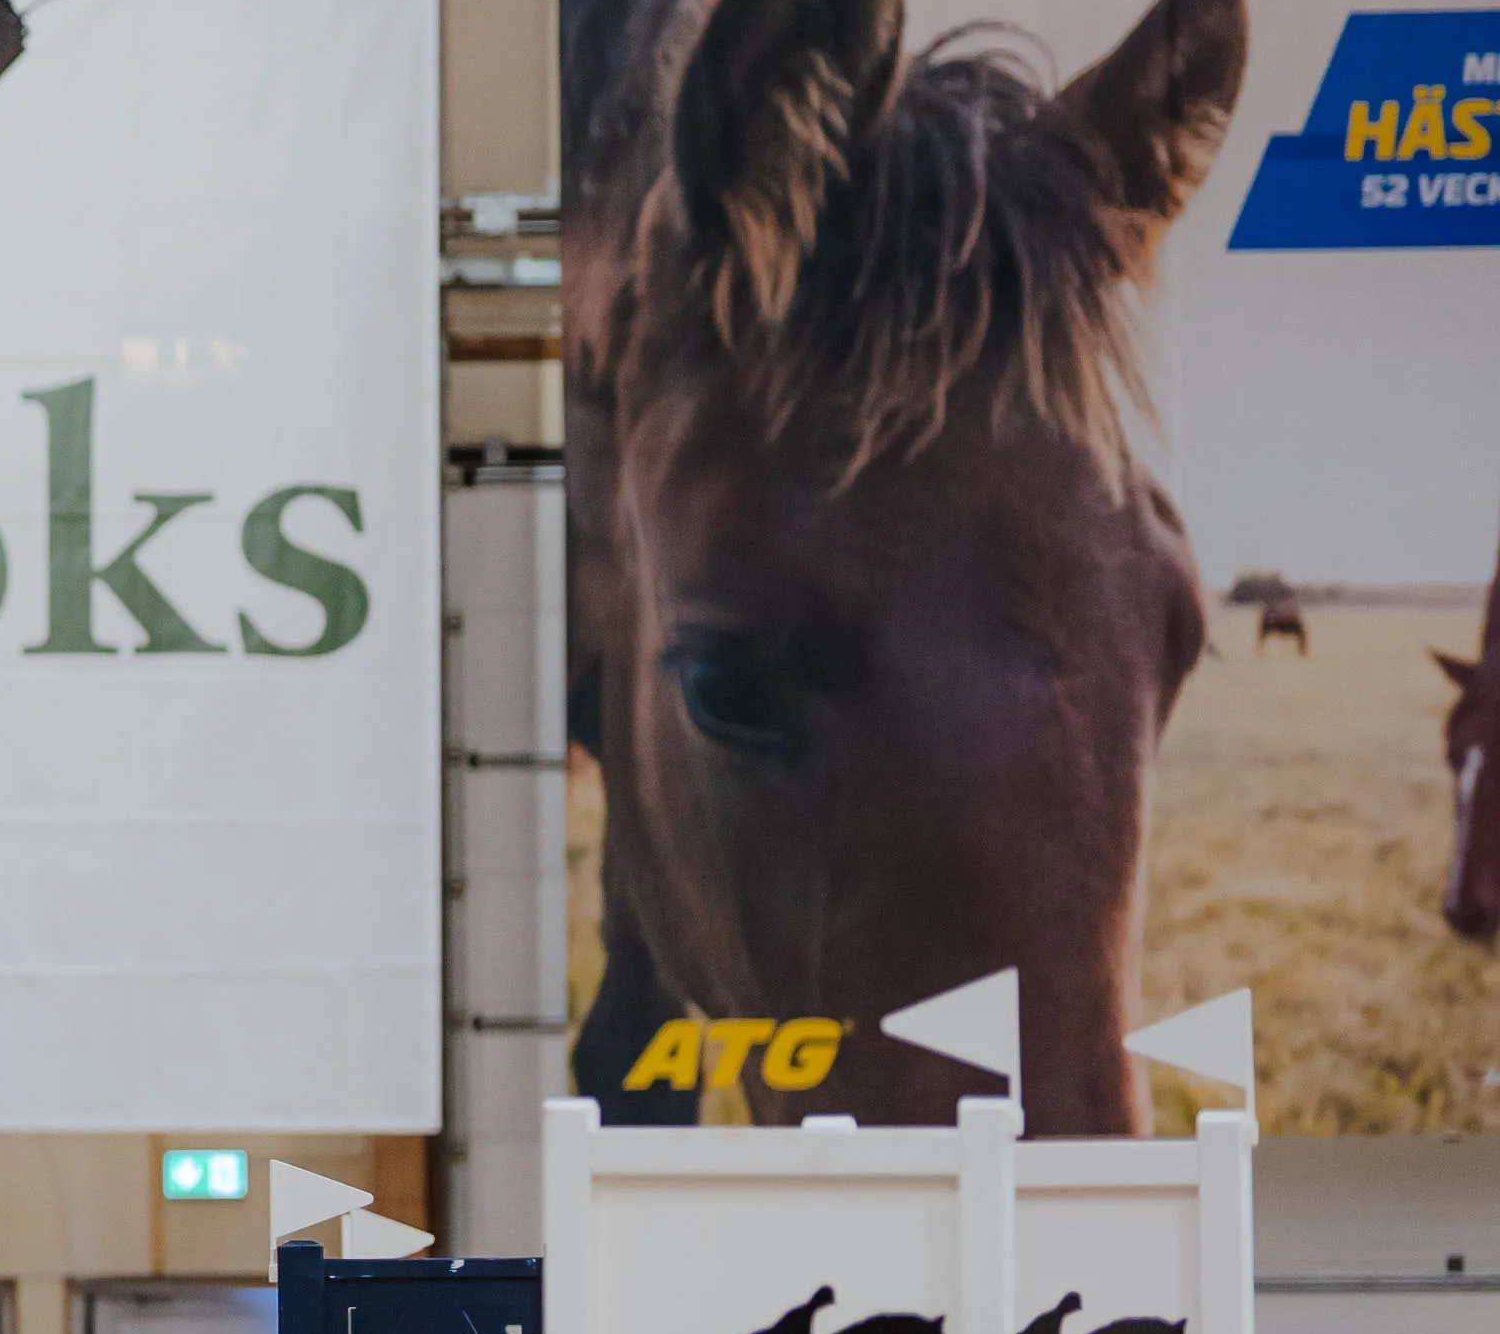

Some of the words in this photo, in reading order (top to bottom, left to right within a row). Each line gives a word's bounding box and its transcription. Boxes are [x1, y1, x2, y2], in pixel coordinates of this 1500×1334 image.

[1462, 52, 1500, 85] M
[1344, 84, 1500, 162] HÄS
[1361, 173, 1410, 208] 52
[622, 1017, 842, 1091] ATG
